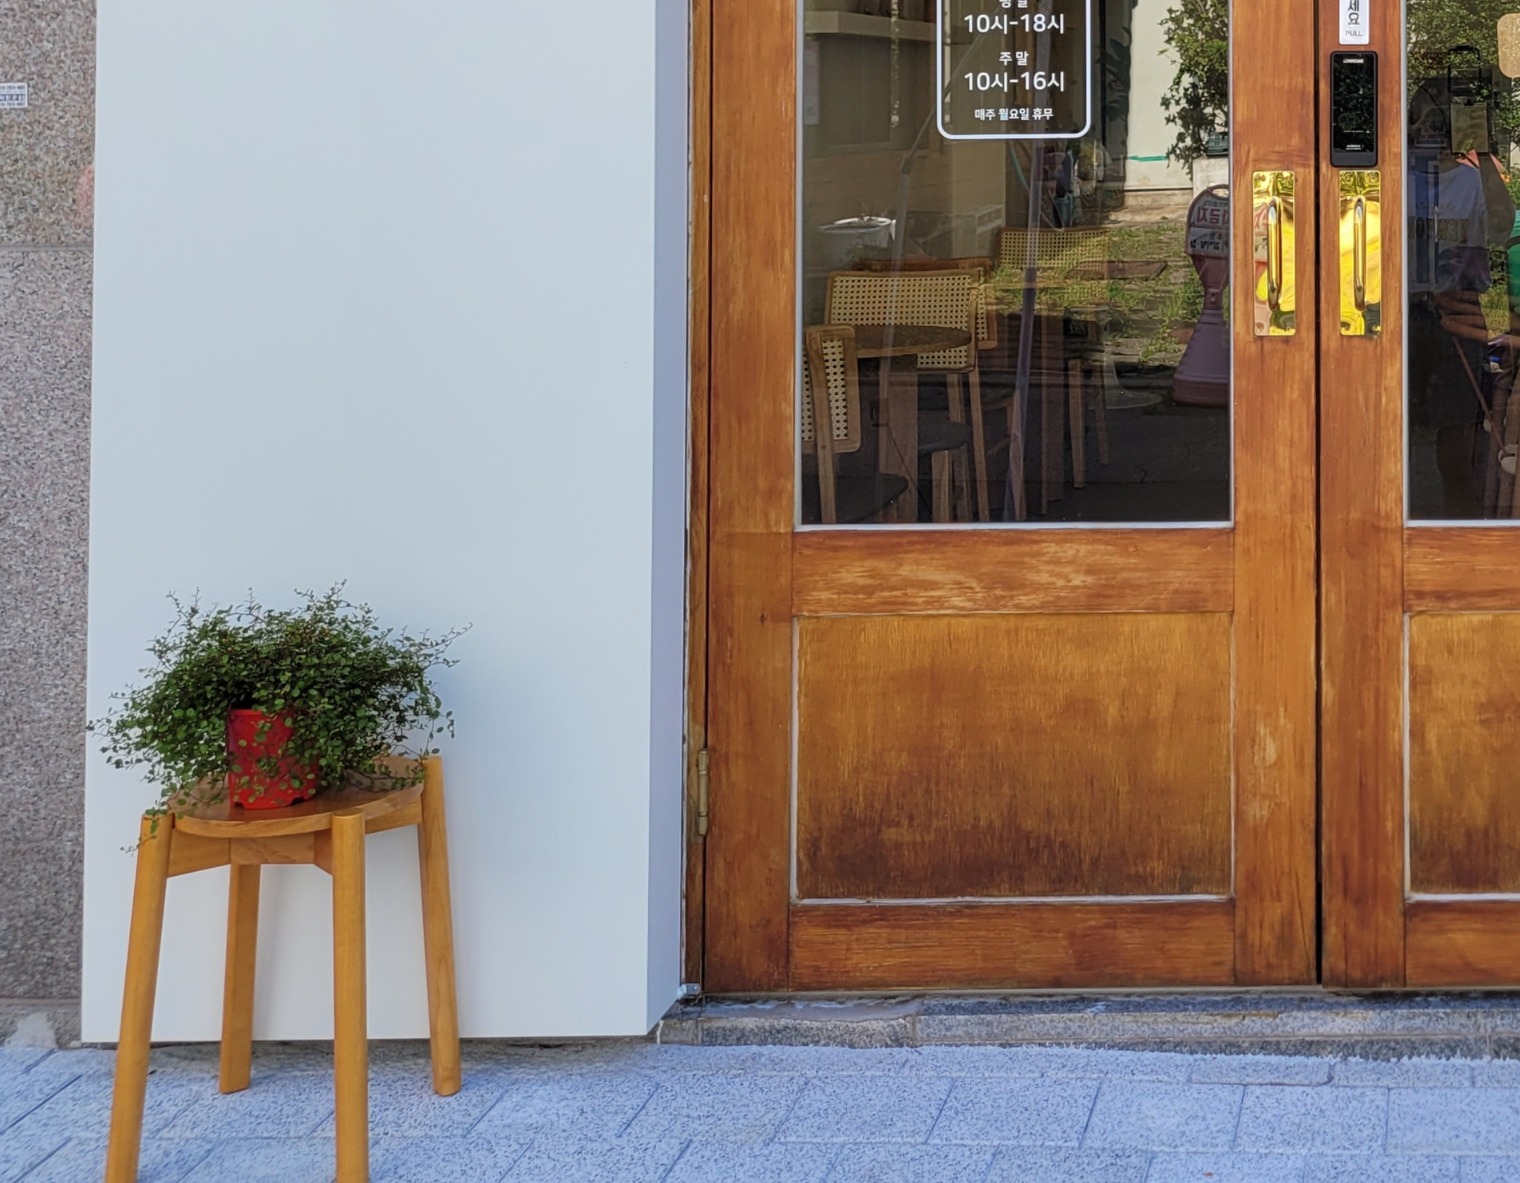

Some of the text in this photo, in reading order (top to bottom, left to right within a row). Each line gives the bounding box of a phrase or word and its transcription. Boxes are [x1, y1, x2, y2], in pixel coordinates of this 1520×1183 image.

[963, 13, 1065, 34] 10시-18시
[998, 51, 1029, 66] 주말
[963, 71, 1065, 92] 10시-16시
[974, 107, 1054, 121] 매주 월요일 휴무
